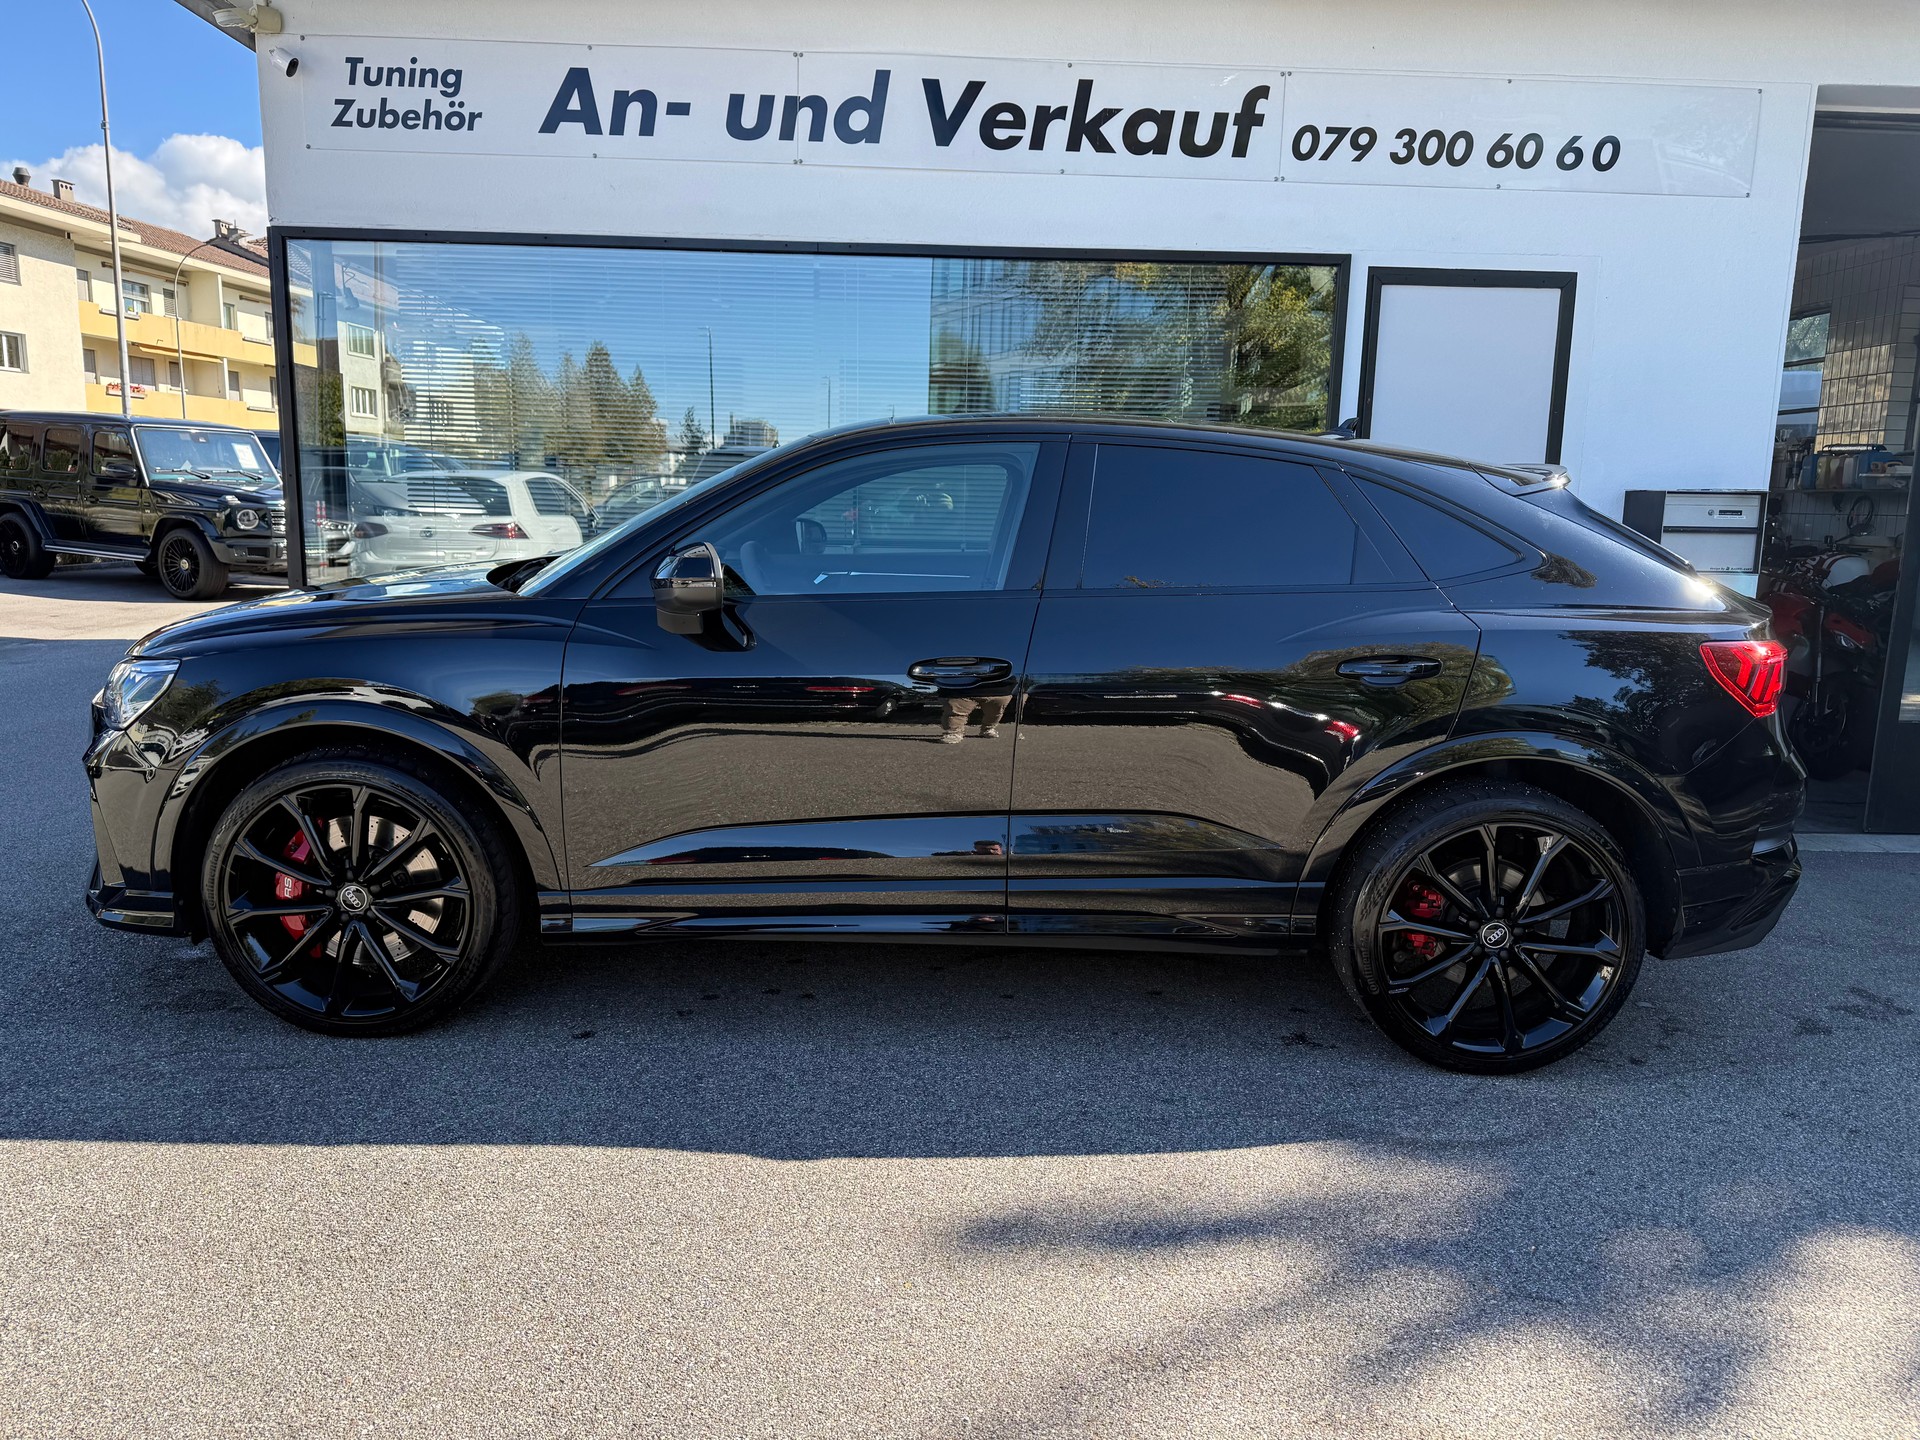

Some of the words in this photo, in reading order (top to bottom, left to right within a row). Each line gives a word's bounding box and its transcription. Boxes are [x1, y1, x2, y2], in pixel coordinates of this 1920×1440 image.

[345, 57, 463, 98] Tuning
[330, 98, 483, 132] Zubehör
[538, 67, 692, 137] An-
[725, 70, 892, 145] und
[922, 78, 1271, 159] Verkauf
[1292, 125, 1378, 162] 079
[1389, 128, 1474, 168] 300
[1487, 133, 1544, 170] 60
[206, 849, 220, 911] Continental
[284, 876, 292, 898] RS
